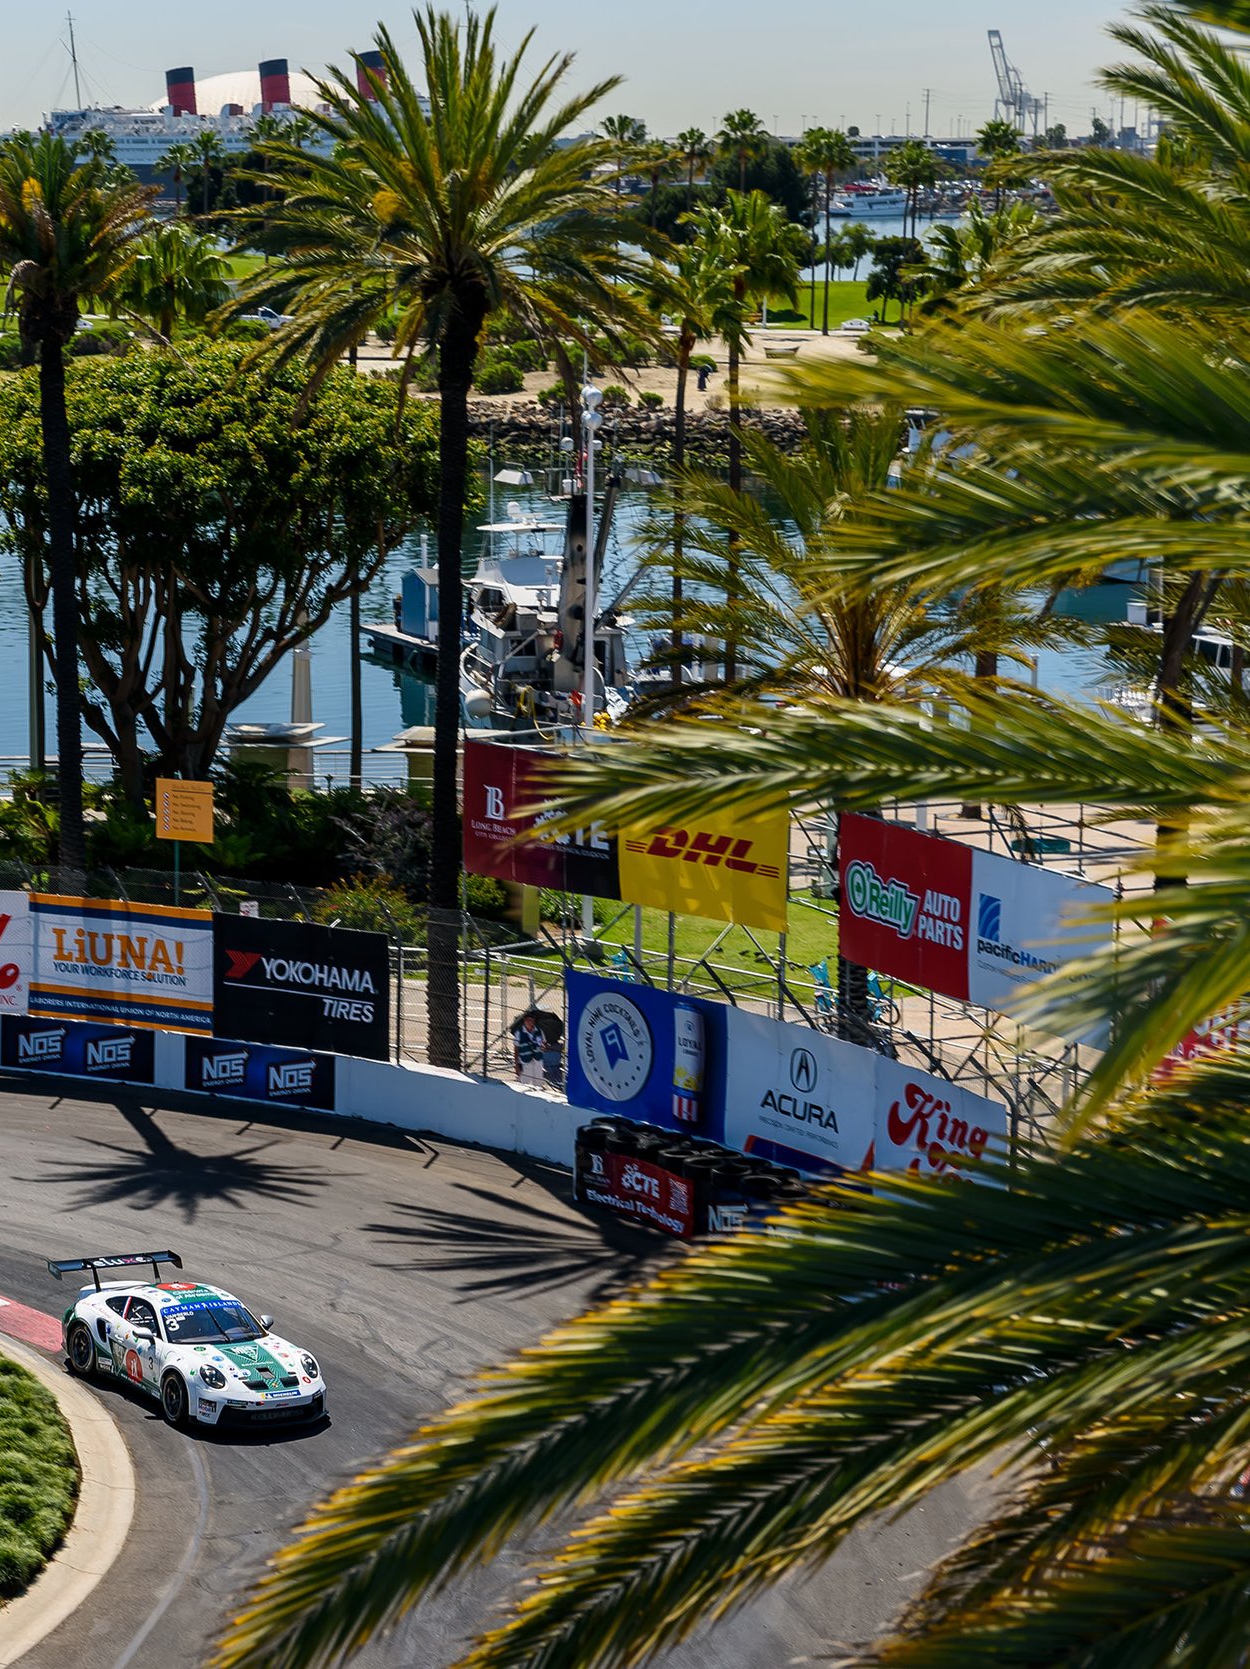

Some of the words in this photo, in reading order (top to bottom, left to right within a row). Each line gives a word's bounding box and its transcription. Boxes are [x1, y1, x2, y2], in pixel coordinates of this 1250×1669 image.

[471, 819, 492, 832] LONG
[492, 823, 517, 836] BEACH
[647, 826, 759, 874] DHL
[848, 863, 918, 935] O'Reilly
[924, 889, 961, 922] AUTO
[917, 914, 964, 951] PARTS
[52, 927, 185, 976] LiUNA!
[53, 961, 80, 975] YOUR
[80, 964, 140, 981] WORKFORCE
[261, 956, 375, 994] YOKOHAMA
[120, 1006, 145, 1016] UNION
[146, 1008, 155, 1016] OF
[322, 998, 375, 1024] TIRES
[587, 1006, 604, 1030] NINE
[603, 1003, 641, 1038] COCKTAILS
[18, 1027, 66, 1057] NOS
[87, 1034, 136, 1066] NOS
[584, 1030, 597, 1064] LOYAL
[202, 1050, 249, 1080] NOS
[269, 1060, 317, 1090] NOS
[759, 1088, 839, 1135] ACURA
[887, 1082, 988, 1160] King
[586, 1188, 634, 1212] Electrical
[636, 1200, 686, 1234] Technology
[708, 1204, 749, 1233] NOS
[163, 1303, 201, 1315] CAYMAN
[165, 1318, 180, 1331] 3
[148, 1356, 154, 1370] 3
